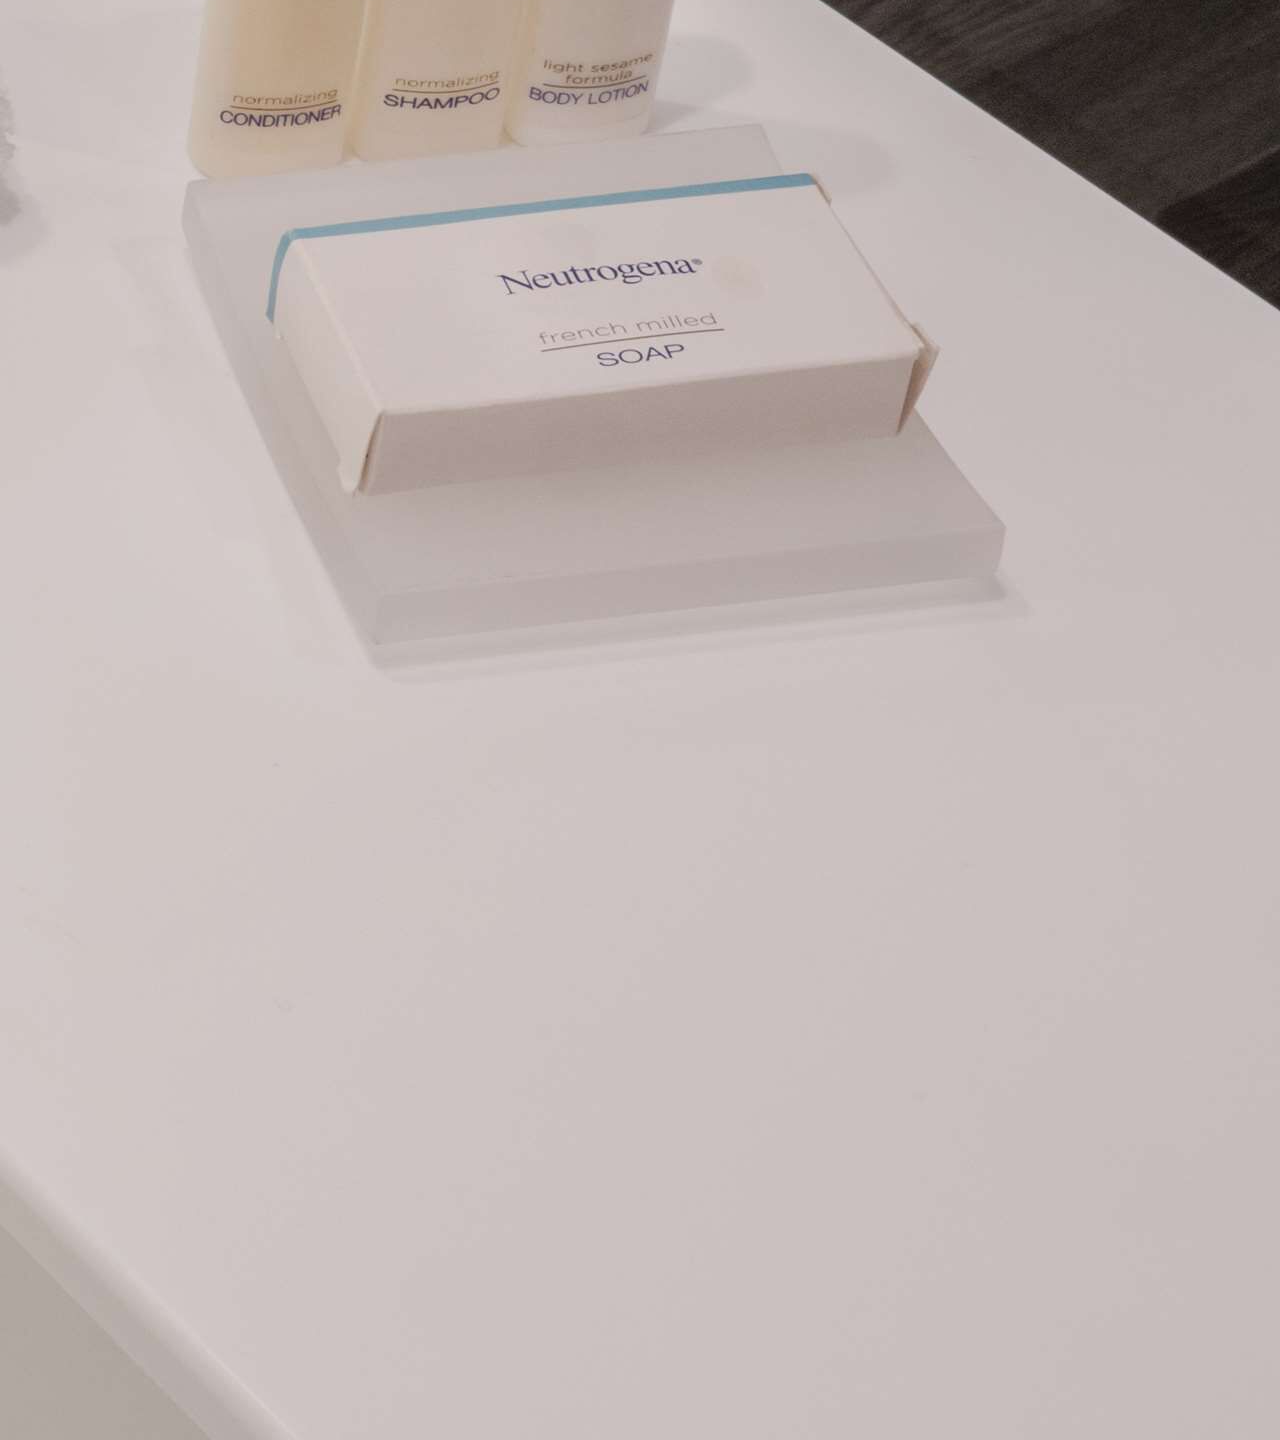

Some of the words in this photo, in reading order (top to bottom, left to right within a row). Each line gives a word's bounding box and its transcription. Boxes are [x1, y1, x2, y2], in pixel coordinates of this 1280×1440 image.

[543, 59, 584, 73] light
[591, 54, 653, 73] sesame
[395, 71, 500, 88] normalizing
[566, 70, 633, 85] formula
[233, 89, 338, 105] normalizing
[384, 87, 500, 109] SHAMPOO
[529, 87, 583, 105] BODY
[588, 80, 650, 104] LOTION
[220, 104, 342, 128] CONDITIONER
[539, 322, 627, 345] french
[636, 312, 718, 332] milled
[597, 343, 685, 367] SOAP
